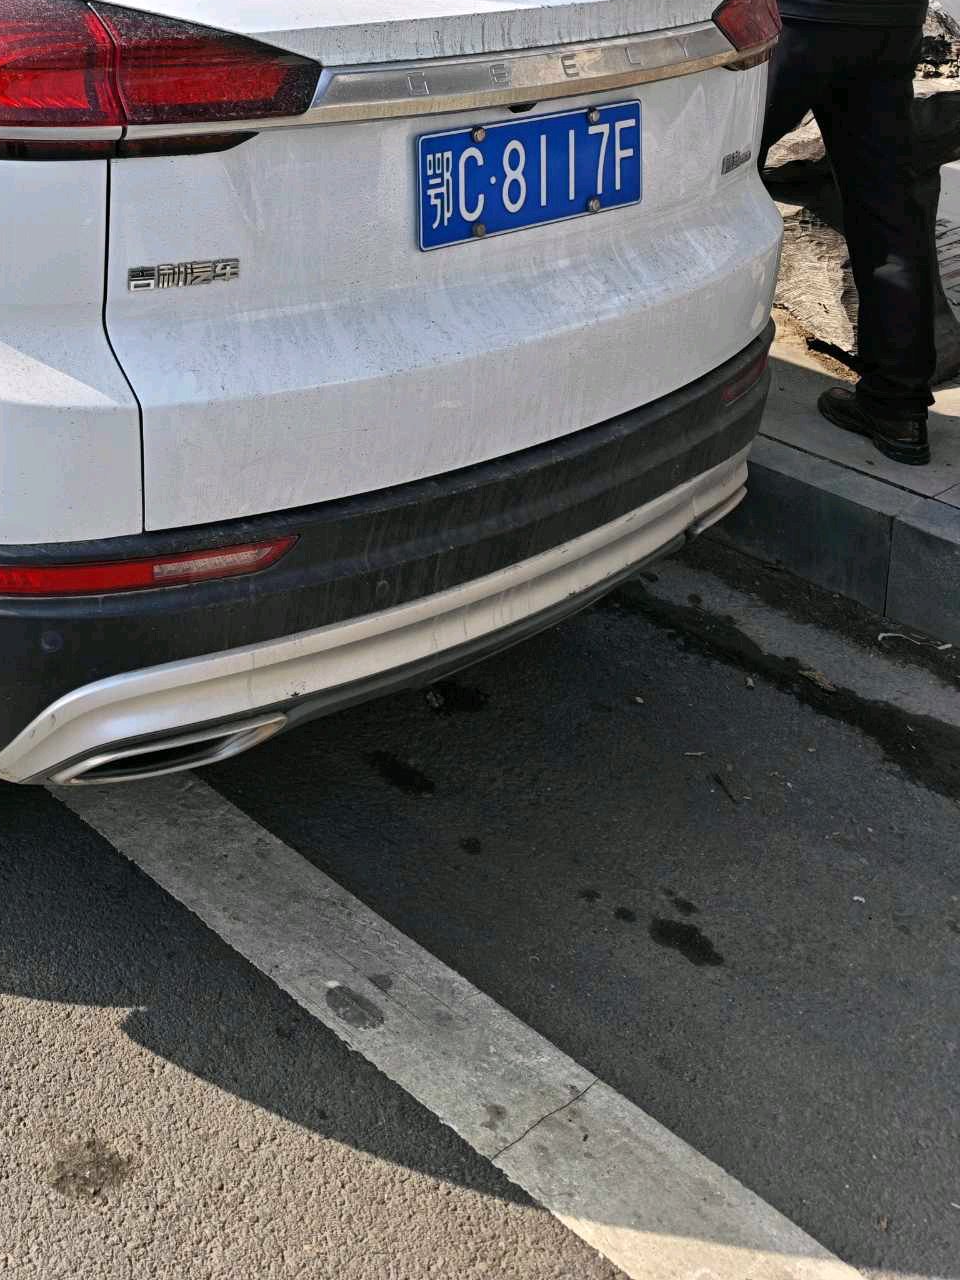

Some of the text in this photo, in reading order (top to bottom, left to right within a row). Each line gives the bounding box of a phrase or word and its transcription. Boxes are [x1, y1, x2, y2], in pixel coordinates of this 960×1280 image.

[407, 37, 690, 96] GEELY
[426, 118, 636, 230] 鄂C·8117F
[127, 258, 240, 292] 吉利汽车
